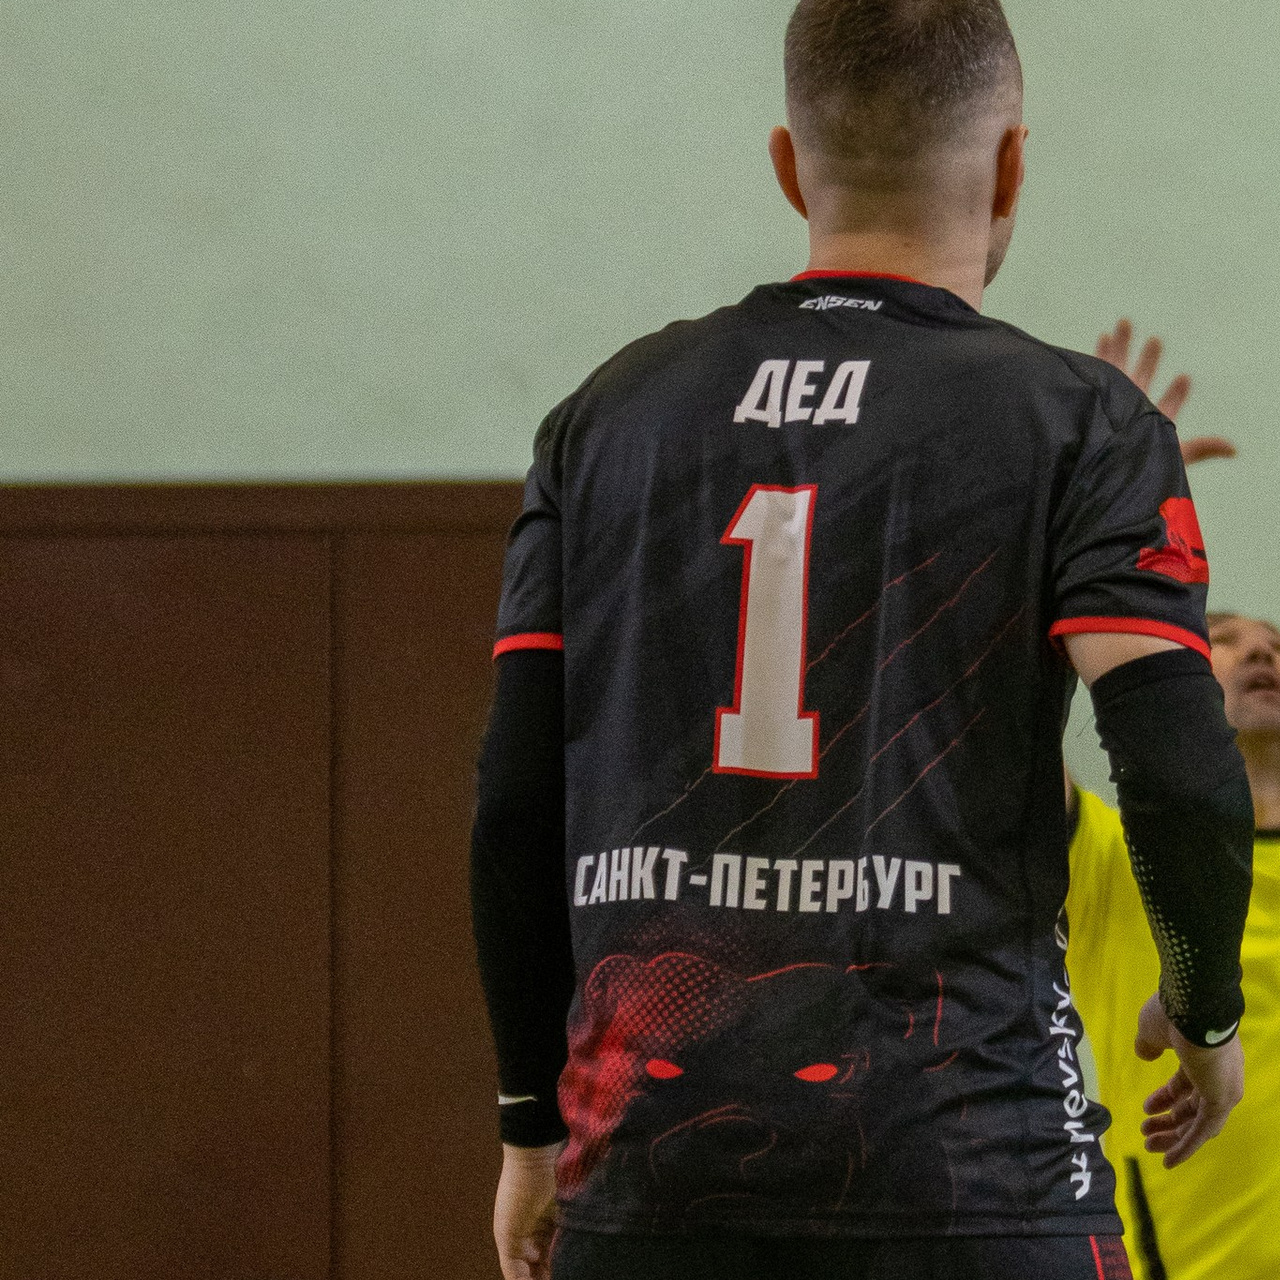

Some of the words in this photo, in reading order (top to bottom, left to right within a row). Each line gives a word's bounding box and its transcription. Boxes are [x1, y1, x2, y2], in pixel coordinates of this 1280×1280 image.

[732, 358, 872, 429] ДЕД
[712, 483, 820, 780] 1
[572, 845, 962, 915] САНКТ-ПЕТЕРБУРГ
